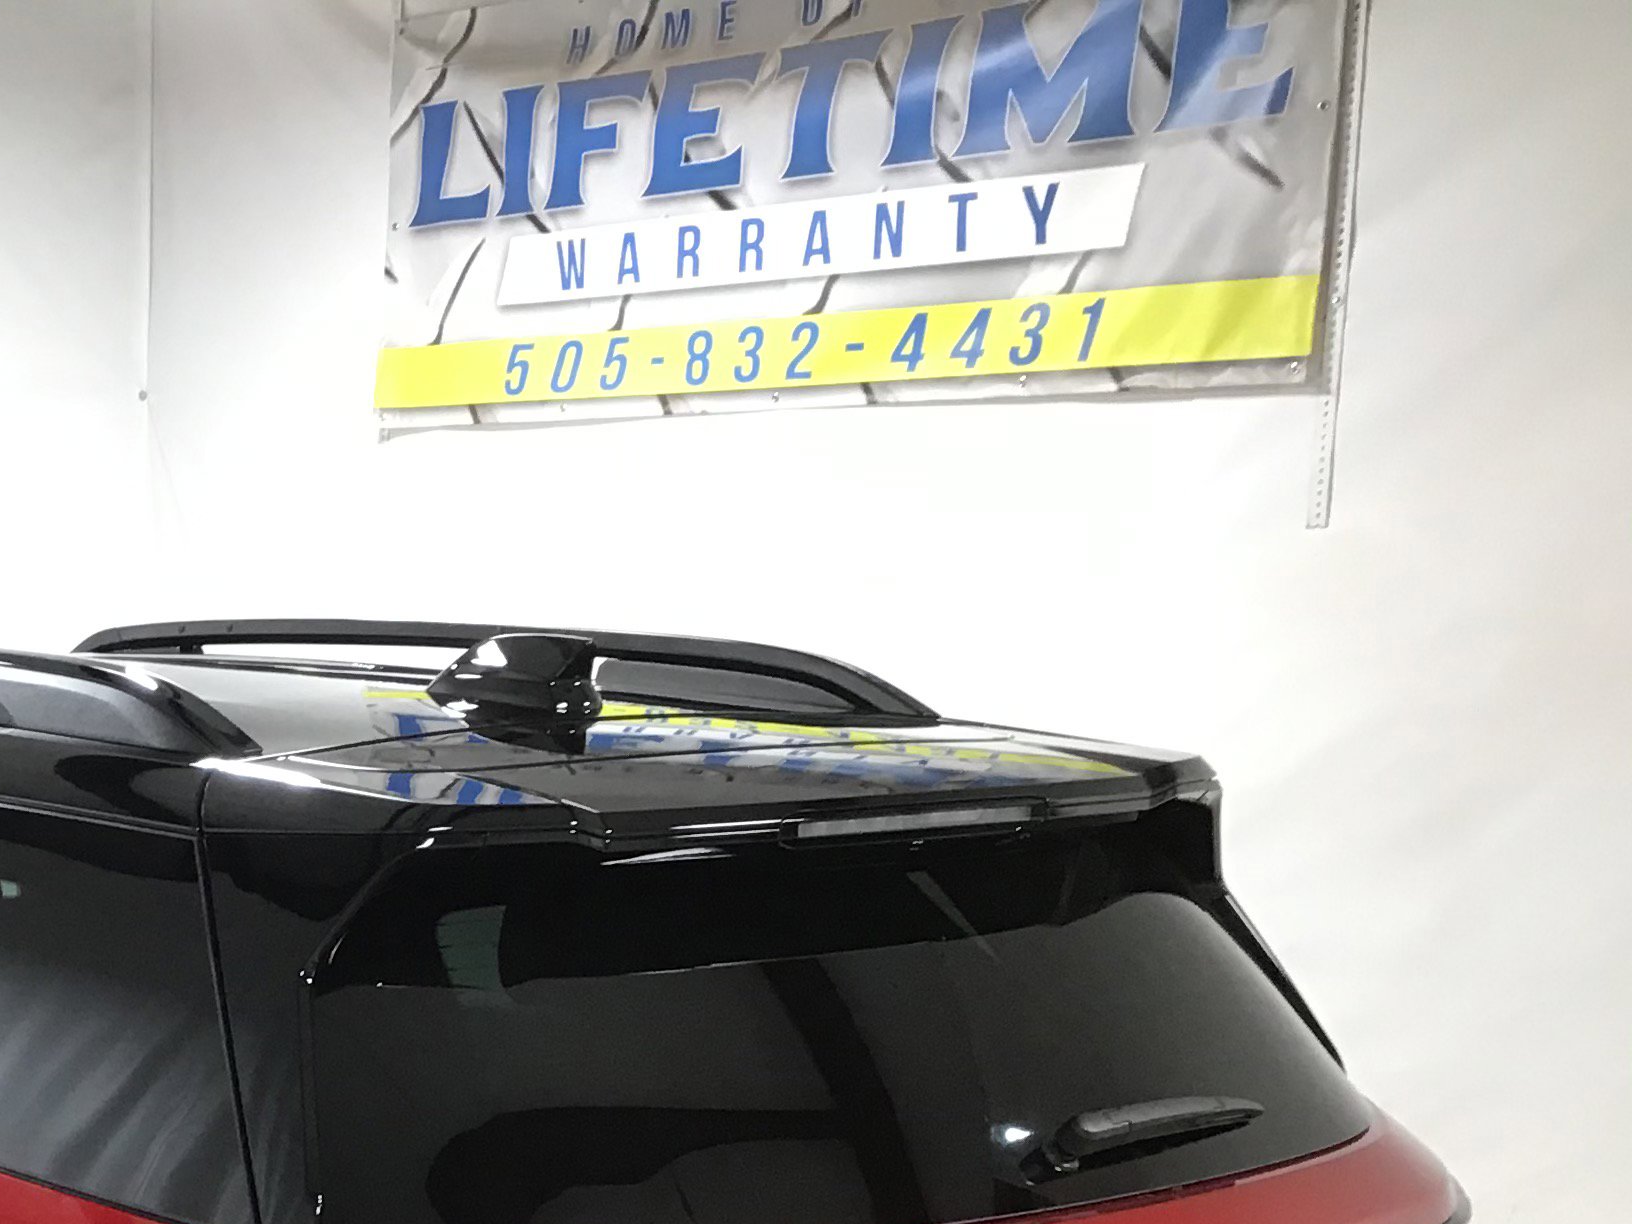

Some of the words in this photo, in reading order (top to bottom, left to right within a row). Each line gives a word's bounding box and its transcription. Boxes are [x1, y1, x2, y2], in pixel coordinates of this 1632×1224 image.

[566, 0, 739, 65] HOME
[408, 0, 1295, 228] LIFETIME
[555, 183, 1061, 290] WARRANTY
[504, 297, 1108, 396] 505-832-4431
